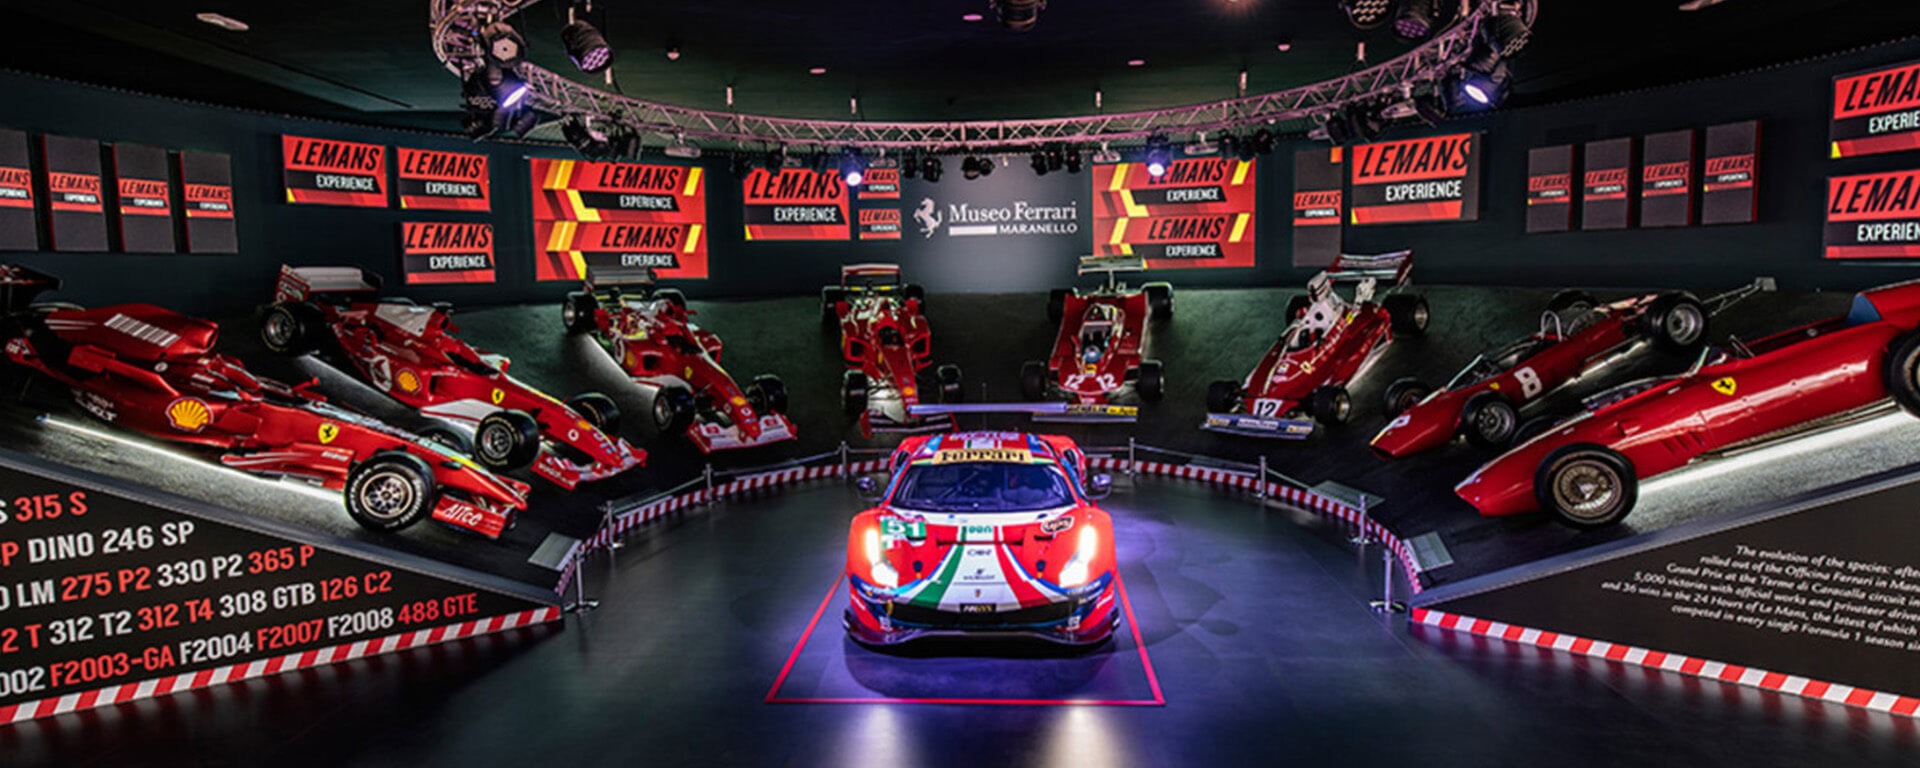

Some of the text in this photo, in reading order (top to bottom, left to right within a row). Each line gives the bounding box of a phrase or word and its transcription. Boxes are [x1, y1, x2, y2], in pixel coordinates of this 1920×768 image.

[1843, 68, 1920, 112] LEMA
[1869, 110, 1920, 133] EXPERIE
[292, 140, 380, 171] LEMANS
[404, 152, 482, 178] LEMANS
[1358, 137, 1471, 178] LEMANS
[52, 175, 99, 191] LEMANS
[121, 181, 167, 197] LEMANS
[316, 174, 373, 191] EXPERIENCE
[425, 181, 478, 196] EXPERIENCE
[598, 165, 678, 190] LEMANS
[750, 171, 841, 199] LEMANS
[188, 187, 231, 201] LEMANS
[620, 195, 673, 208] EXPERIENCE
[1166, 187, 1219, 202] EXPERIENCE
[1295, 191, 1339, 207] LEMANS
[1386, 180, 1462, 201] EXPERIENCE
[774, 207, 837, 222] EXPERIENCE
[949, 201, 1077, 222] Museo Ferrari
[406, 223, 492, 249] LEMANS
[601, 225, 679, 248] LEMANS
[1000, 223, 1078, 234] MARANELLO
[1148, 217, 1224, 240] LEMANS
[429, 254, 486, 270] EXPERIENCE
[621, 253, 673, 267] EXPERIENCE
[1166, 244, 1217, 257] EXPERIENCE
[1096, 373, 1118, 391] 12
[1513, 366, 1543, 399] 8
[1257, 401, 1277, 418] 12
[14, 494, 62, 521] 315
[69, 491, 88, 515] S
[887, 520, 920, 537] 51
[0, 521, 194, 567] P DINO 246 SP
[1736, 545, 1757, 557] The
[1759, 550, 1808, 563] evolution
[1811, 555, 1826, 567] of
[1826, 557, 1845, 568] the
[16, 579, 55, 607] LM
[61, 572, 113, 601] 275
[118, 567, 151, 592] P2
[157, 559, 206, 587] 330
[212, 554, 243, 579] P2
[248, 548, 294, 574] 365
[300, 545, 315, 567] P
[1700, 555, 1731, 567] rolled
[1731, 561, 1750, 570] out
[1752, 561, 1766, 573] of
[1765, 563, 1783, 573] the
[1785, 565, 1831, 580] Officina
[1832, 571, 1874, 586] Ferrari
[1875, 577, 1888, 588] in
[1634, 571, 1666, 585] 5,000
[1667, 577, 1708, 591] victories
[1710, 583, 1734, 594] with
[1735, 586, 1773, 599] official
[1774, 594, 1806, 605] works
[1808, 599, 1833, 609] and
[1832, 601, 1887, 616] privateer
[1666, 562, 1700, 576] Grand
[1701, 567, 1723, 578] Prix
[1725, 572, 1738, 581] at
[1739, 574, 1757, 584] the
[1760, 575, 1795, 589] Terme
[1796, 580, 1809, 591] di
[1811, 582, 1866, 599] Caracalla
[1868, 592, 1906, 605] circuit
[24, 624, 42, 648] T
[49, 616, 94, 644] 312
[99, 610, 132, 636] T2
[138, 603, 179, 631] 312
[185, 598, 214, 623] T4
[219, 591, 267, 618] 308
[273, 582, 316, 608] GTB
[320, 576, 358, 601] 126
[364, 570, 392, 594] C2
[1601, 581, 1917, 636] and 36 wins in the 24 Hours of Le Mans, the latest of which
[1671, 605, 1722, 619] competed
[1723, 609, 1735, 621] in
[1736, 615, 1765, 629] every
[1767, 619, 1799, 633] single
[1801, 623, 1850, 639] Formula
[1855, 631, 1861, 641] 1
[1864, 635, 1905, 648] season
[50, 645, 175, 687] F2003-GA
[179, 631, 253, 664] F2004
[257, 619, 324, 651] F2007
[327, 607, 394, 638] F2008
[398, 600, 439, 624] 488
[443, 593, 478, 617] GTE
